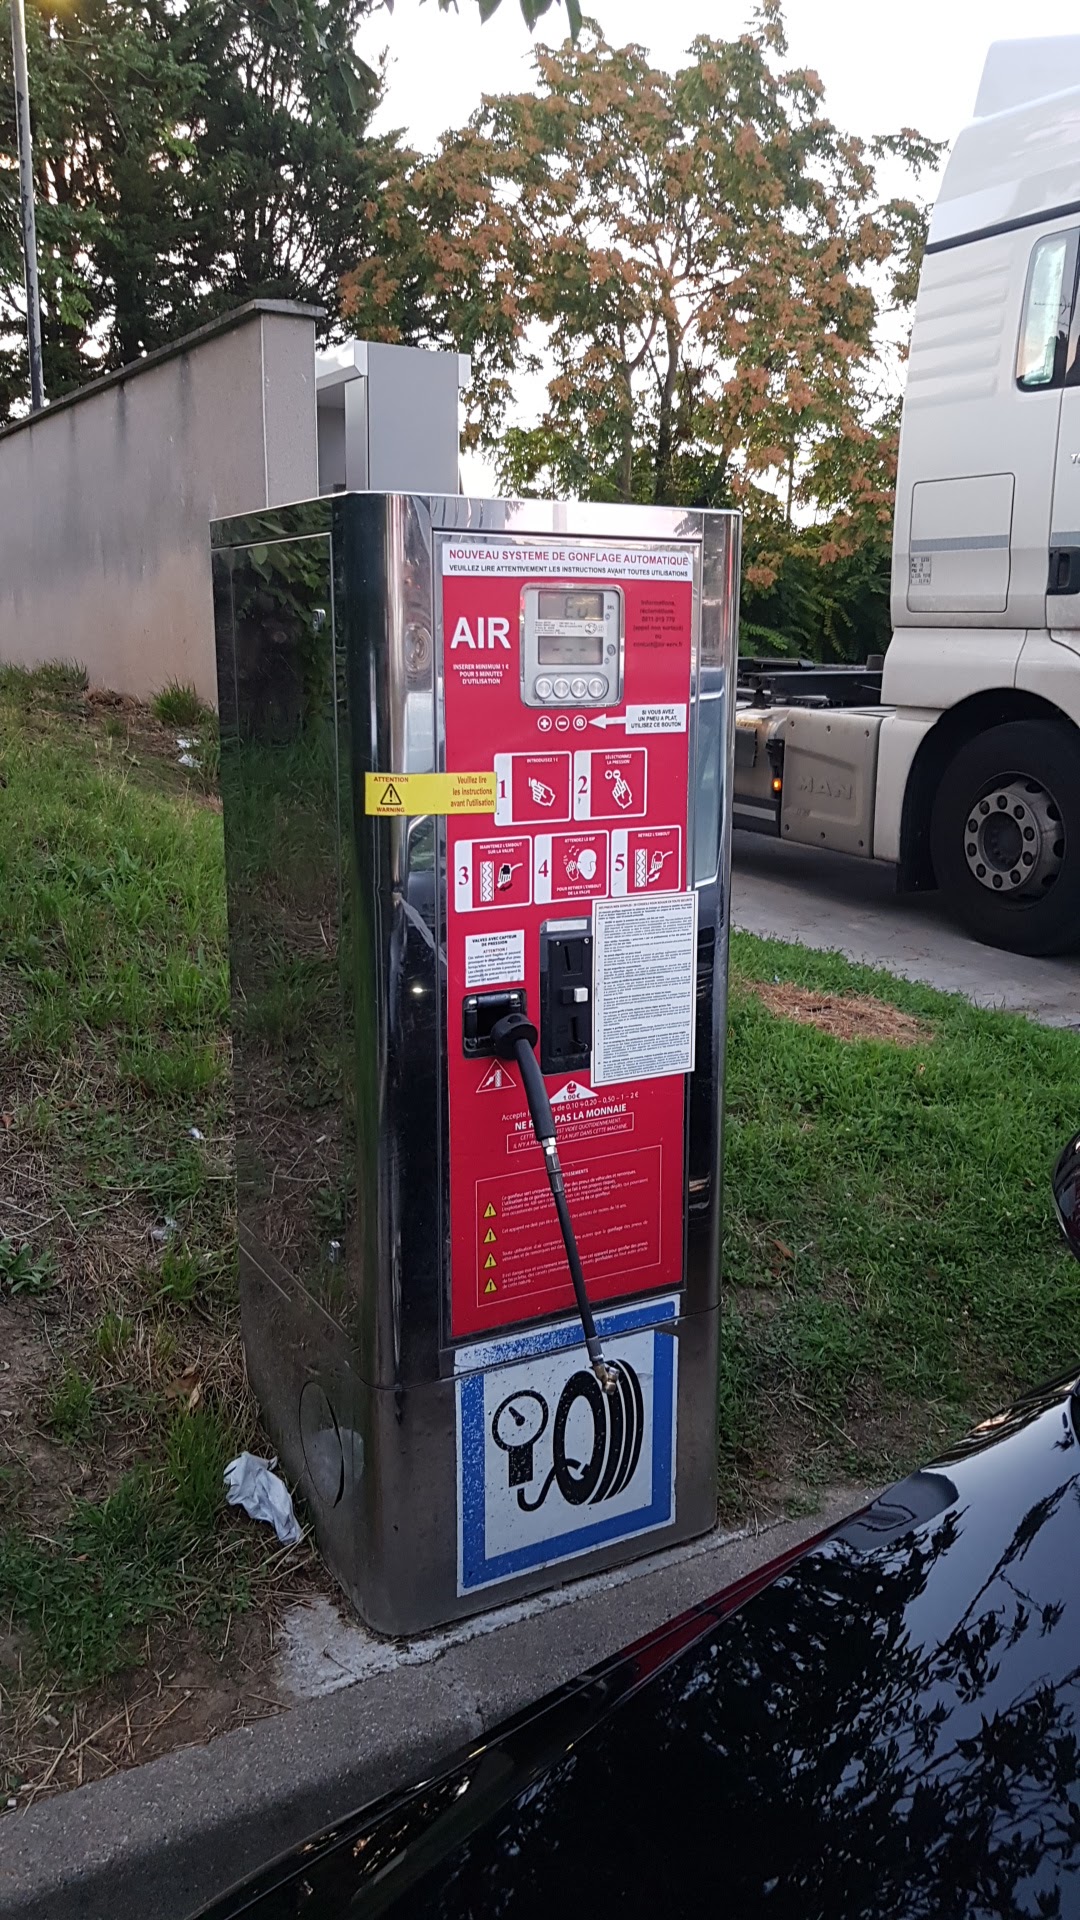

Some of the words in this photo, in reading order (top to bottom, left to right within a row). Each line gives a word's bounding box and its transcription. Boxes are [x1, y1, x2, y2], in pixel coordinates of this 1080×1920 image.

[449, 549, 499, 559] NOUVEAU
[502, 550, 549, 561] SYSTEME
[552, 551, 566, 560] DE
[568, 552, 622, 563] GONFLAGE
[623, 554, 689, 566] AUTOMATIQUE
[496, 565, 547, 573] ATTENTIVEMENT
[561, 566, 606, 574] INSTRUCTIONS
[607, 567, 626, 575] AVANT
[627, 568, 650, 576] TOUTES
[651, 569, 688, 577] UTILISATIONS
[450, 617, 511, 649] AIR
[457, 776, 478, 784] Veuillez
[478, 776, 487, 784] lire
[577, 775, 588, 794] 2
[452, 788, 461, 796] les
[461, 787, 493, 796] instructions
[498, 779, 507, 799] 1
[466, 799, 495, 807] l'utilisation
[538, 859, 549, 878] 4
[614, 853, 625, 872] 5
[458, 866, 469, 886] 3
[565, 1100, 579, 1110] 0,10
[584, 1096, 598, 1107] 0,20
[602, 1094, 616, 1105] 0,50
[501, 1112, 527, 1121] Accepte
[554, 1112, 572, 1124] PAS
[573, 1110, 585, 1120] LA
[585, 1103, 627, 1118] MONNAIE
[514, 1120, 527, 1131] NE
